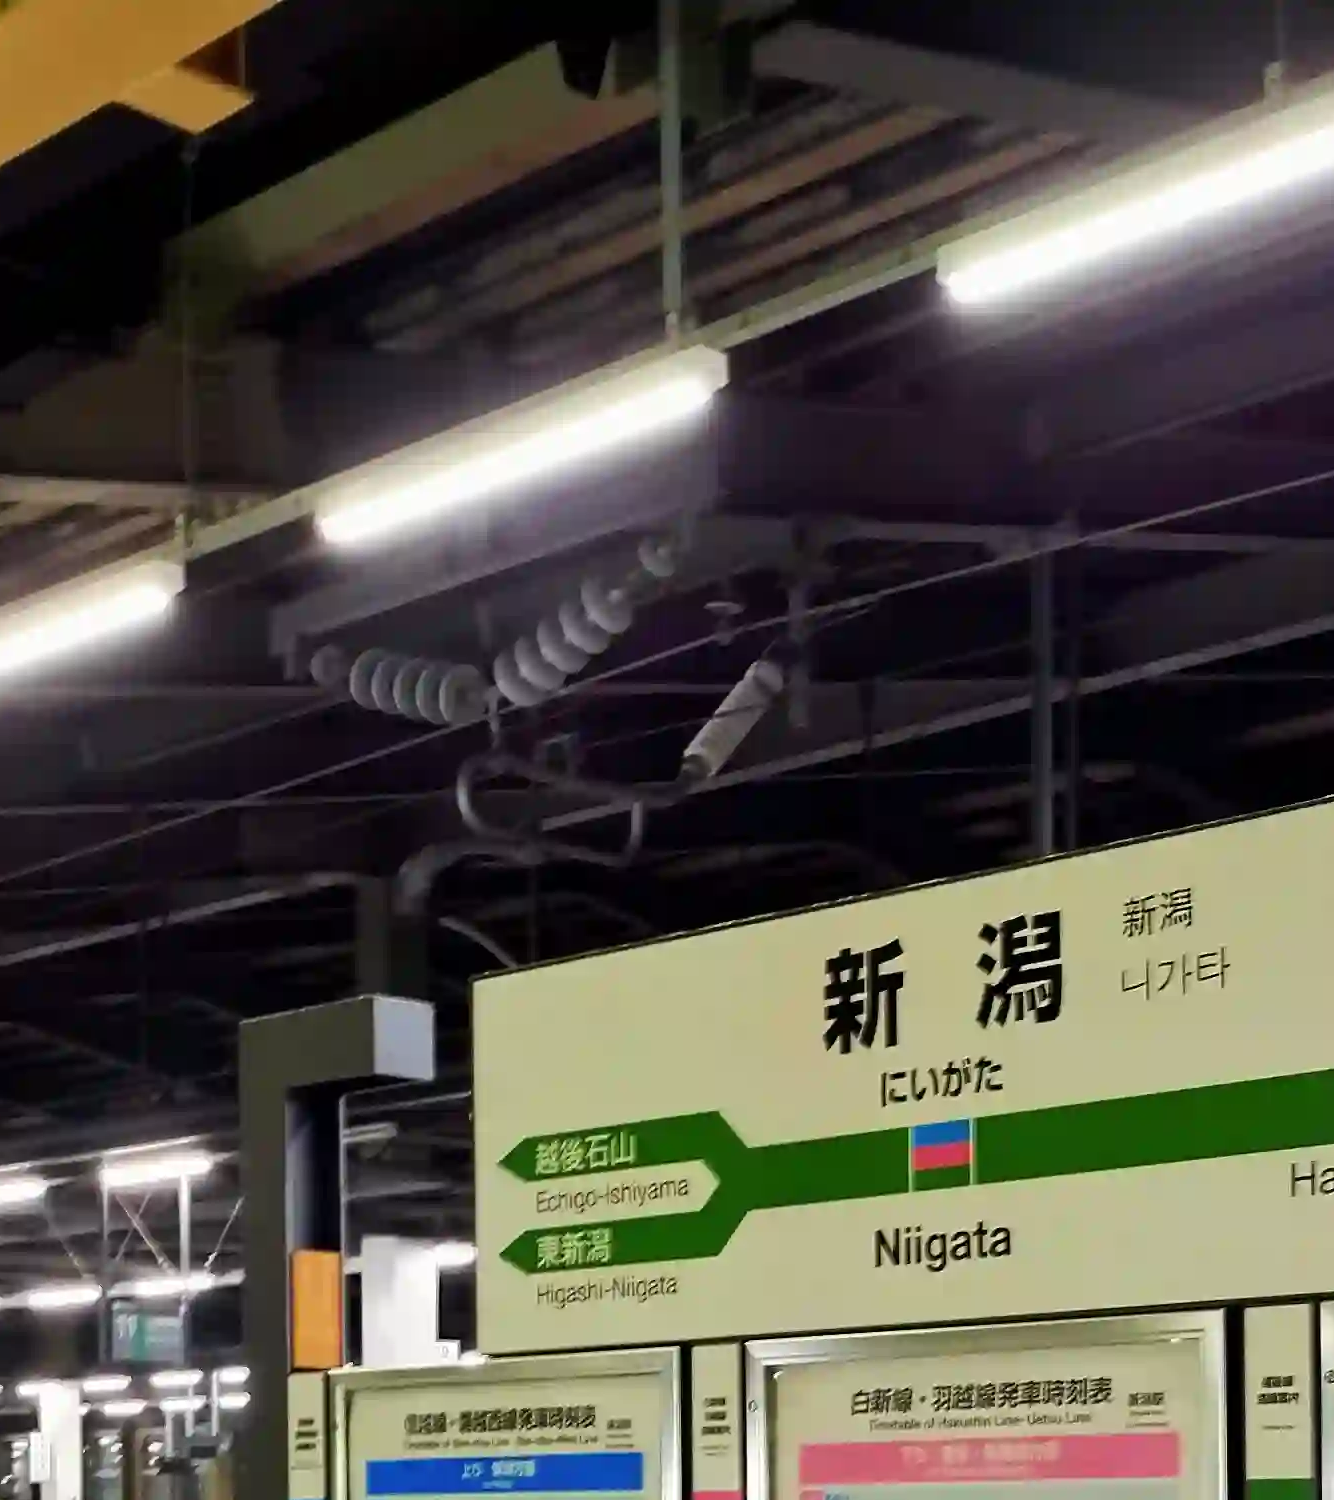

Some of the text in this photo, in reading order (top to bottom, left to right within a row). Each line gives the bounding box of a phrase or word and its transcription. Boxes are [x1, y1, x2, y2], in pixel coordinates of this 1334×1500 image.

[1122, 887, 1194, 938] 新潟
[823, 908, 1064, 1054] 新潟
[1121, 946, 1231, 1000] 니가타
[880, 1056, 1004, 1107] にいがた
[535, 1131, 638, 1176] 越後石山
[536, 1178, 689, 1214] Echigo-Ishiyama
[535, 1227, 613, 1268] 東新潟
[874, 1220, 1012, 1273] Niigata
[536, 1275, 679, 1309] Higashi-Niigata
